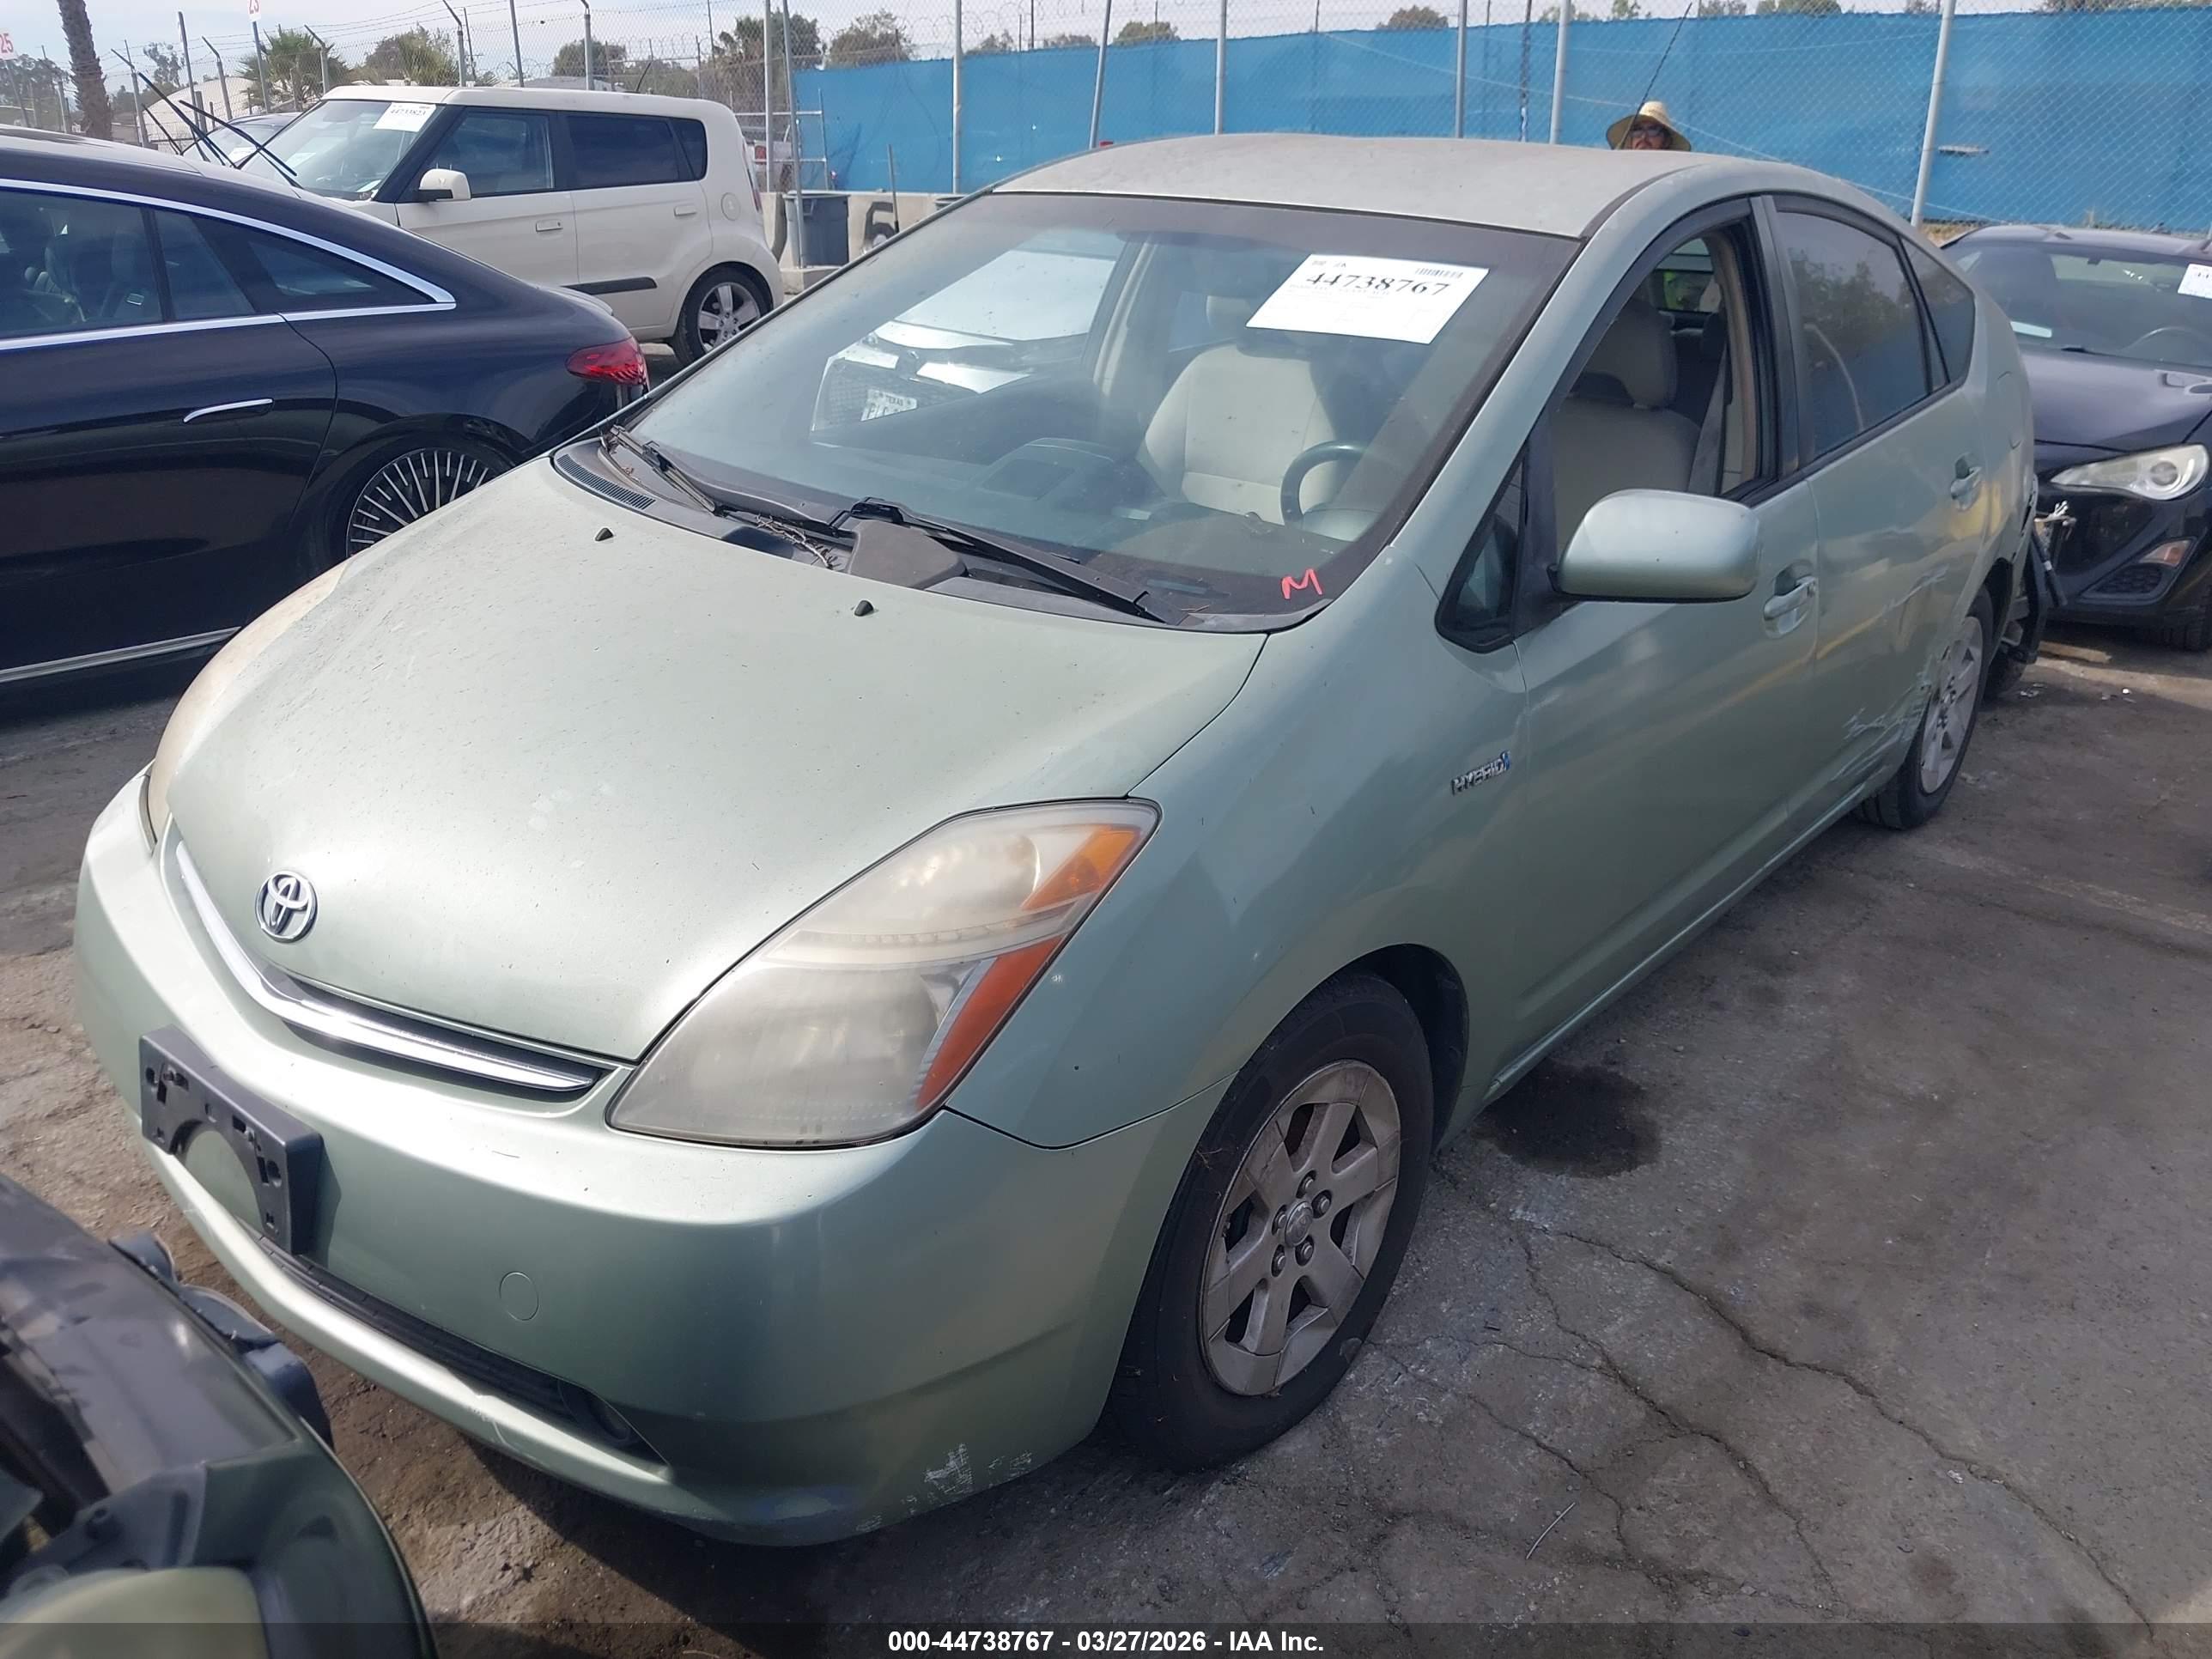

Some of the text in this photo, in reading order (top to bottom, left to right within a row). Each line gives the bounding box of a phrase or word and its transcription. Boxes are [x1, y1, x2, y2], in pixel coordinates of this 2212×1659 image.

[1305, 272, 1451, 296] 44738767
[1281, 568, 1323, 599] M
[1451, 757, 1505, 795] HYBRID
